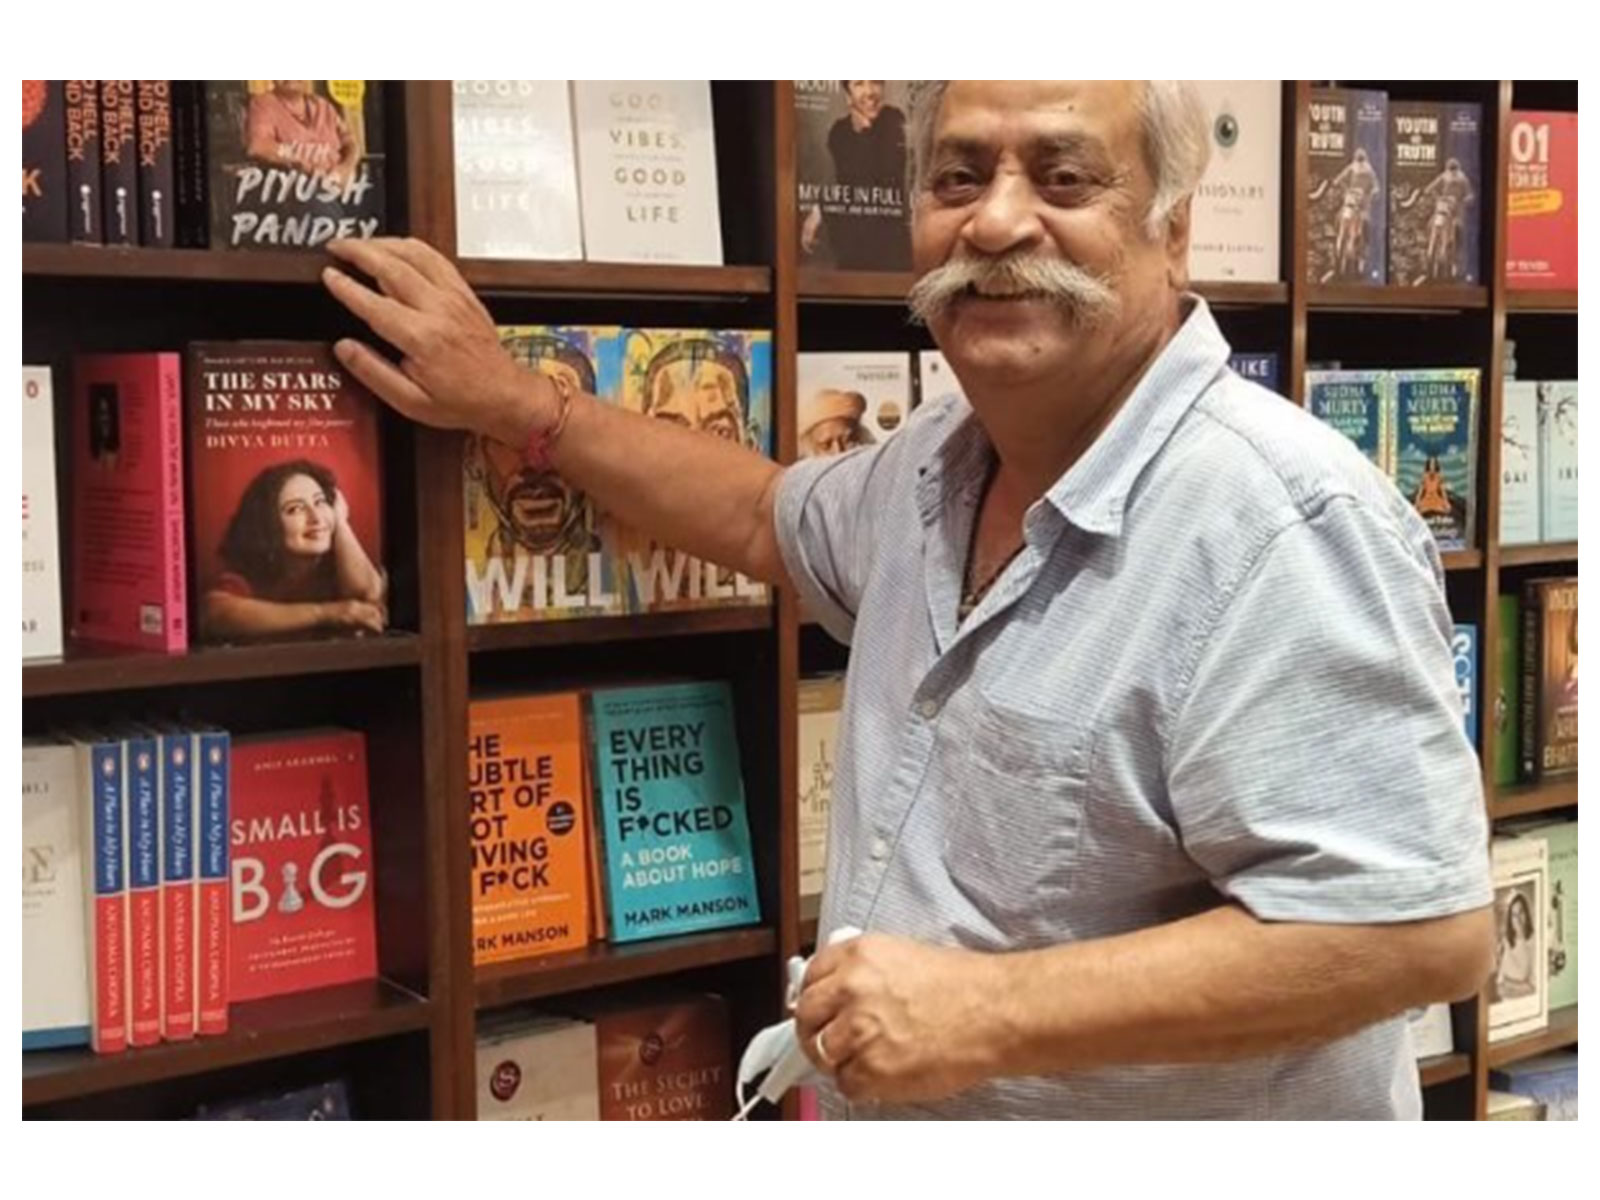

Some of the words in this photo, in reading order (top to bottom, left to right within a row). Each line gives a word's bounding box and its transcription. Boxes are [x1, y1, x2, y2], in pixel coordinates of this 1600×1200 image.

[65, 80, 82, 104] ND
[101, 80, 118, 108] ND
[138, 80, 155, 111] ND
[83, 93, 98, 140] HELL
[119, 98, 135, 145] HELL
[154, 101, 171, 148] HELL
[1308, 102, 1347, 122] OUTH
[1395, 116, 1439, 134] YOUTH
[67, 107, 84, 161] BACK
[102, 110, 120, 164] BACK
[138, 114, 156, 166] BACK
[1510, 121, 1549, 163] 01
[1396, 143, 1437, 160] TRUTH
[235, 164, 374, 205] PIYUSH
[614, 166, 687, 186] GOOD
[472, 193, 531, 212] LIFE
[799, 183, 820, 200] MY
[822, 185, 851, 204] LIFE
[853, 187, 869, 205] IN
[872, 187, 903, 207] FULL
[625, 204, 681, 223] LIFE
[203, 371, 256, 390] THE
[262, 371, 342, 391] STARS
[205, 393, 234, 412] IN
[241, 393, 281, 412] MY
[287, 393, 336, 412] SKY
[206, 434, 266, 449] DIVYA
[271, 434, 330, 449] DUTTA
[465, 552, 622, 615] WILL
[627, 548, 766, 605] WILL
[469, 734, 501, 759] HE
[609, 721, 705, 755] EVERY
[468, 755, 554, 787] UBTLE
[611, 750, 705, 784] THING
[469, 787, 505, 814] RT
[514, 782, 551, 808] OF
[615, 785, 642, 813] IS
[230, 810, 327, 846] SMALL
[337, 804, 362, 831] IS
[471, 814, 508, 841] OT
[472, 837, 548, 869] IVING
[620, 851, 635, 868] A
[637, 844, 693, 868] BOOK
[622, 865, 687, 890] ABOUT
[692, 857, 743, 880] HOPE
[624, 905, 673, 926] MARK
[676, 895, 750, 918] MANSON
[476, 935, 498, 951] RK
[501, 923, 569, 948] MANSON
[612, 1080, 649, 1101] THE
[656, 1066, 721, 1093] SECRET
[626, 1101, 653, 1121] TO
[659, 1091, 706, 1116] LOVE
